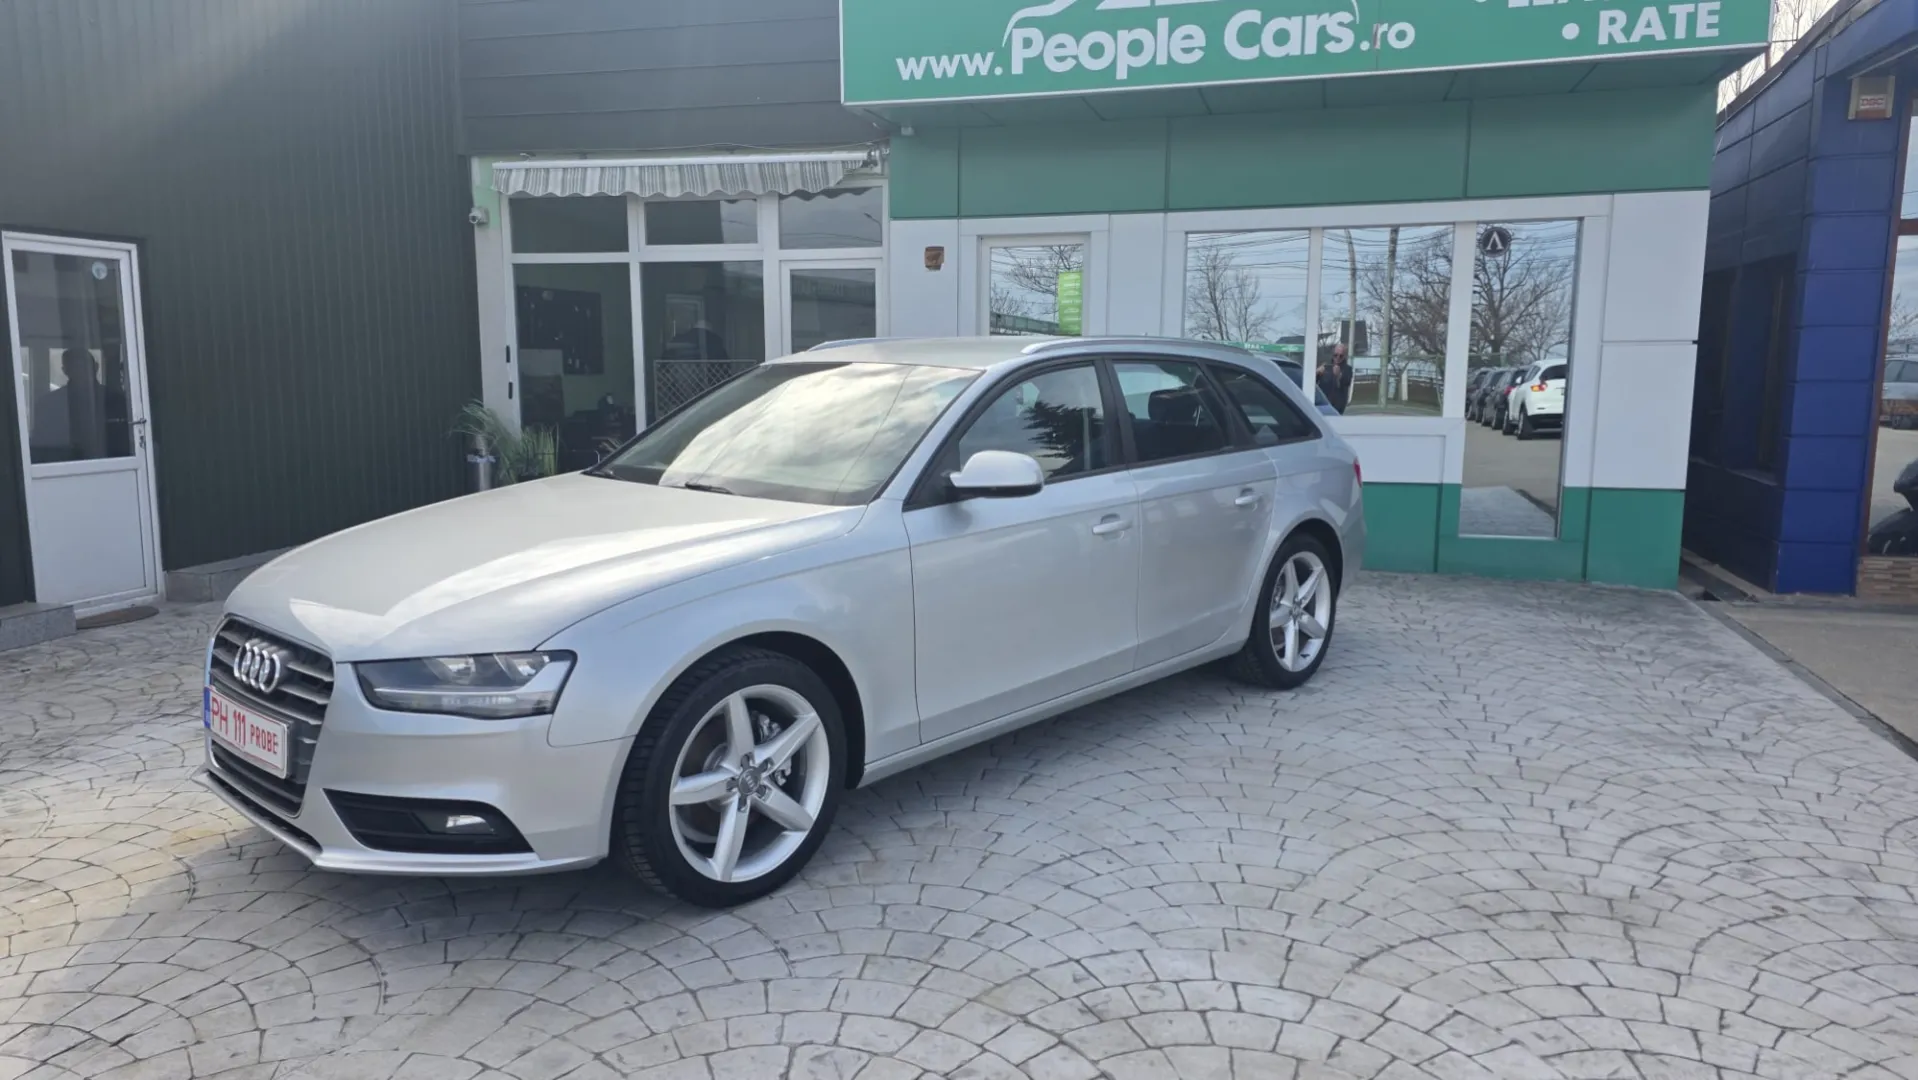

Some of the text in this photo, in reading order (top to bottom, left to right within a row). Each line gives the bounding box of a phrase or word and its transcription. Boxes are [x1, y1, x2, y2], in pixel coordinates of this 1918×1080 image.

[1598, 2, 1721, 45] RATE
[211, 696, 279, 755] PH 111 PROBE
